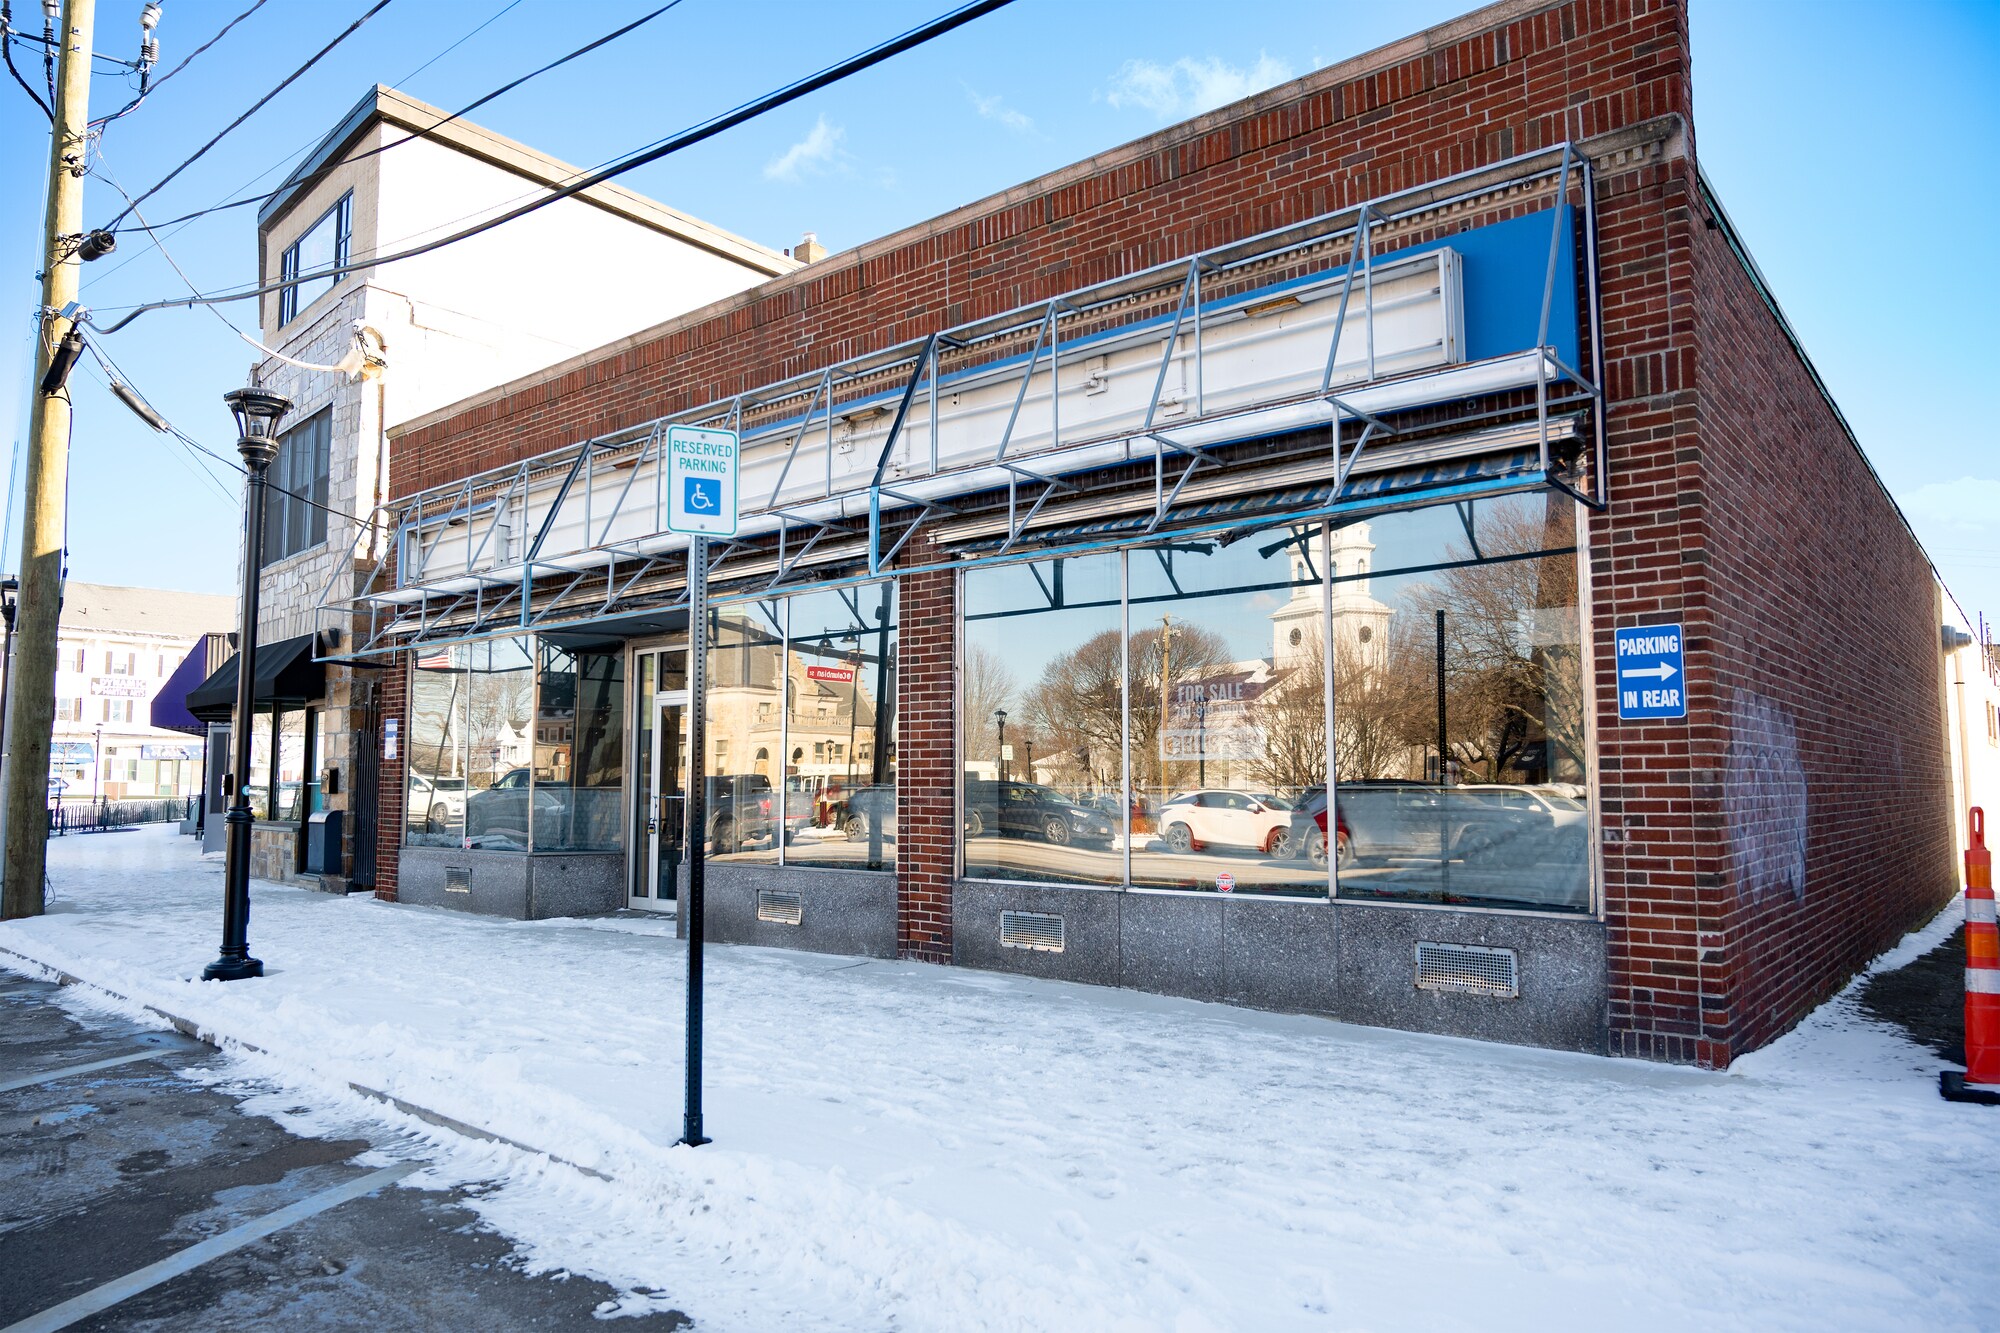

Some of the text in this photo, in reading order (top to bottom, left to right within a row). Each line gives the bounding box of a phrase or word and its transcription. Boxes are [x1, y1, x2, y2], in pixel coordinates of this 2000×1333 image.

[674, 440, 732, 458] RESERVED
[680, 458, 726, 473] PARKING
[1619, 635, 1678, 656] PARKING
[100, 678, 146, 688] DYNAMIC
[1178, 682, 1242, 702] FOR SALE
[1623, 689, 1680, 709] IN REAR
